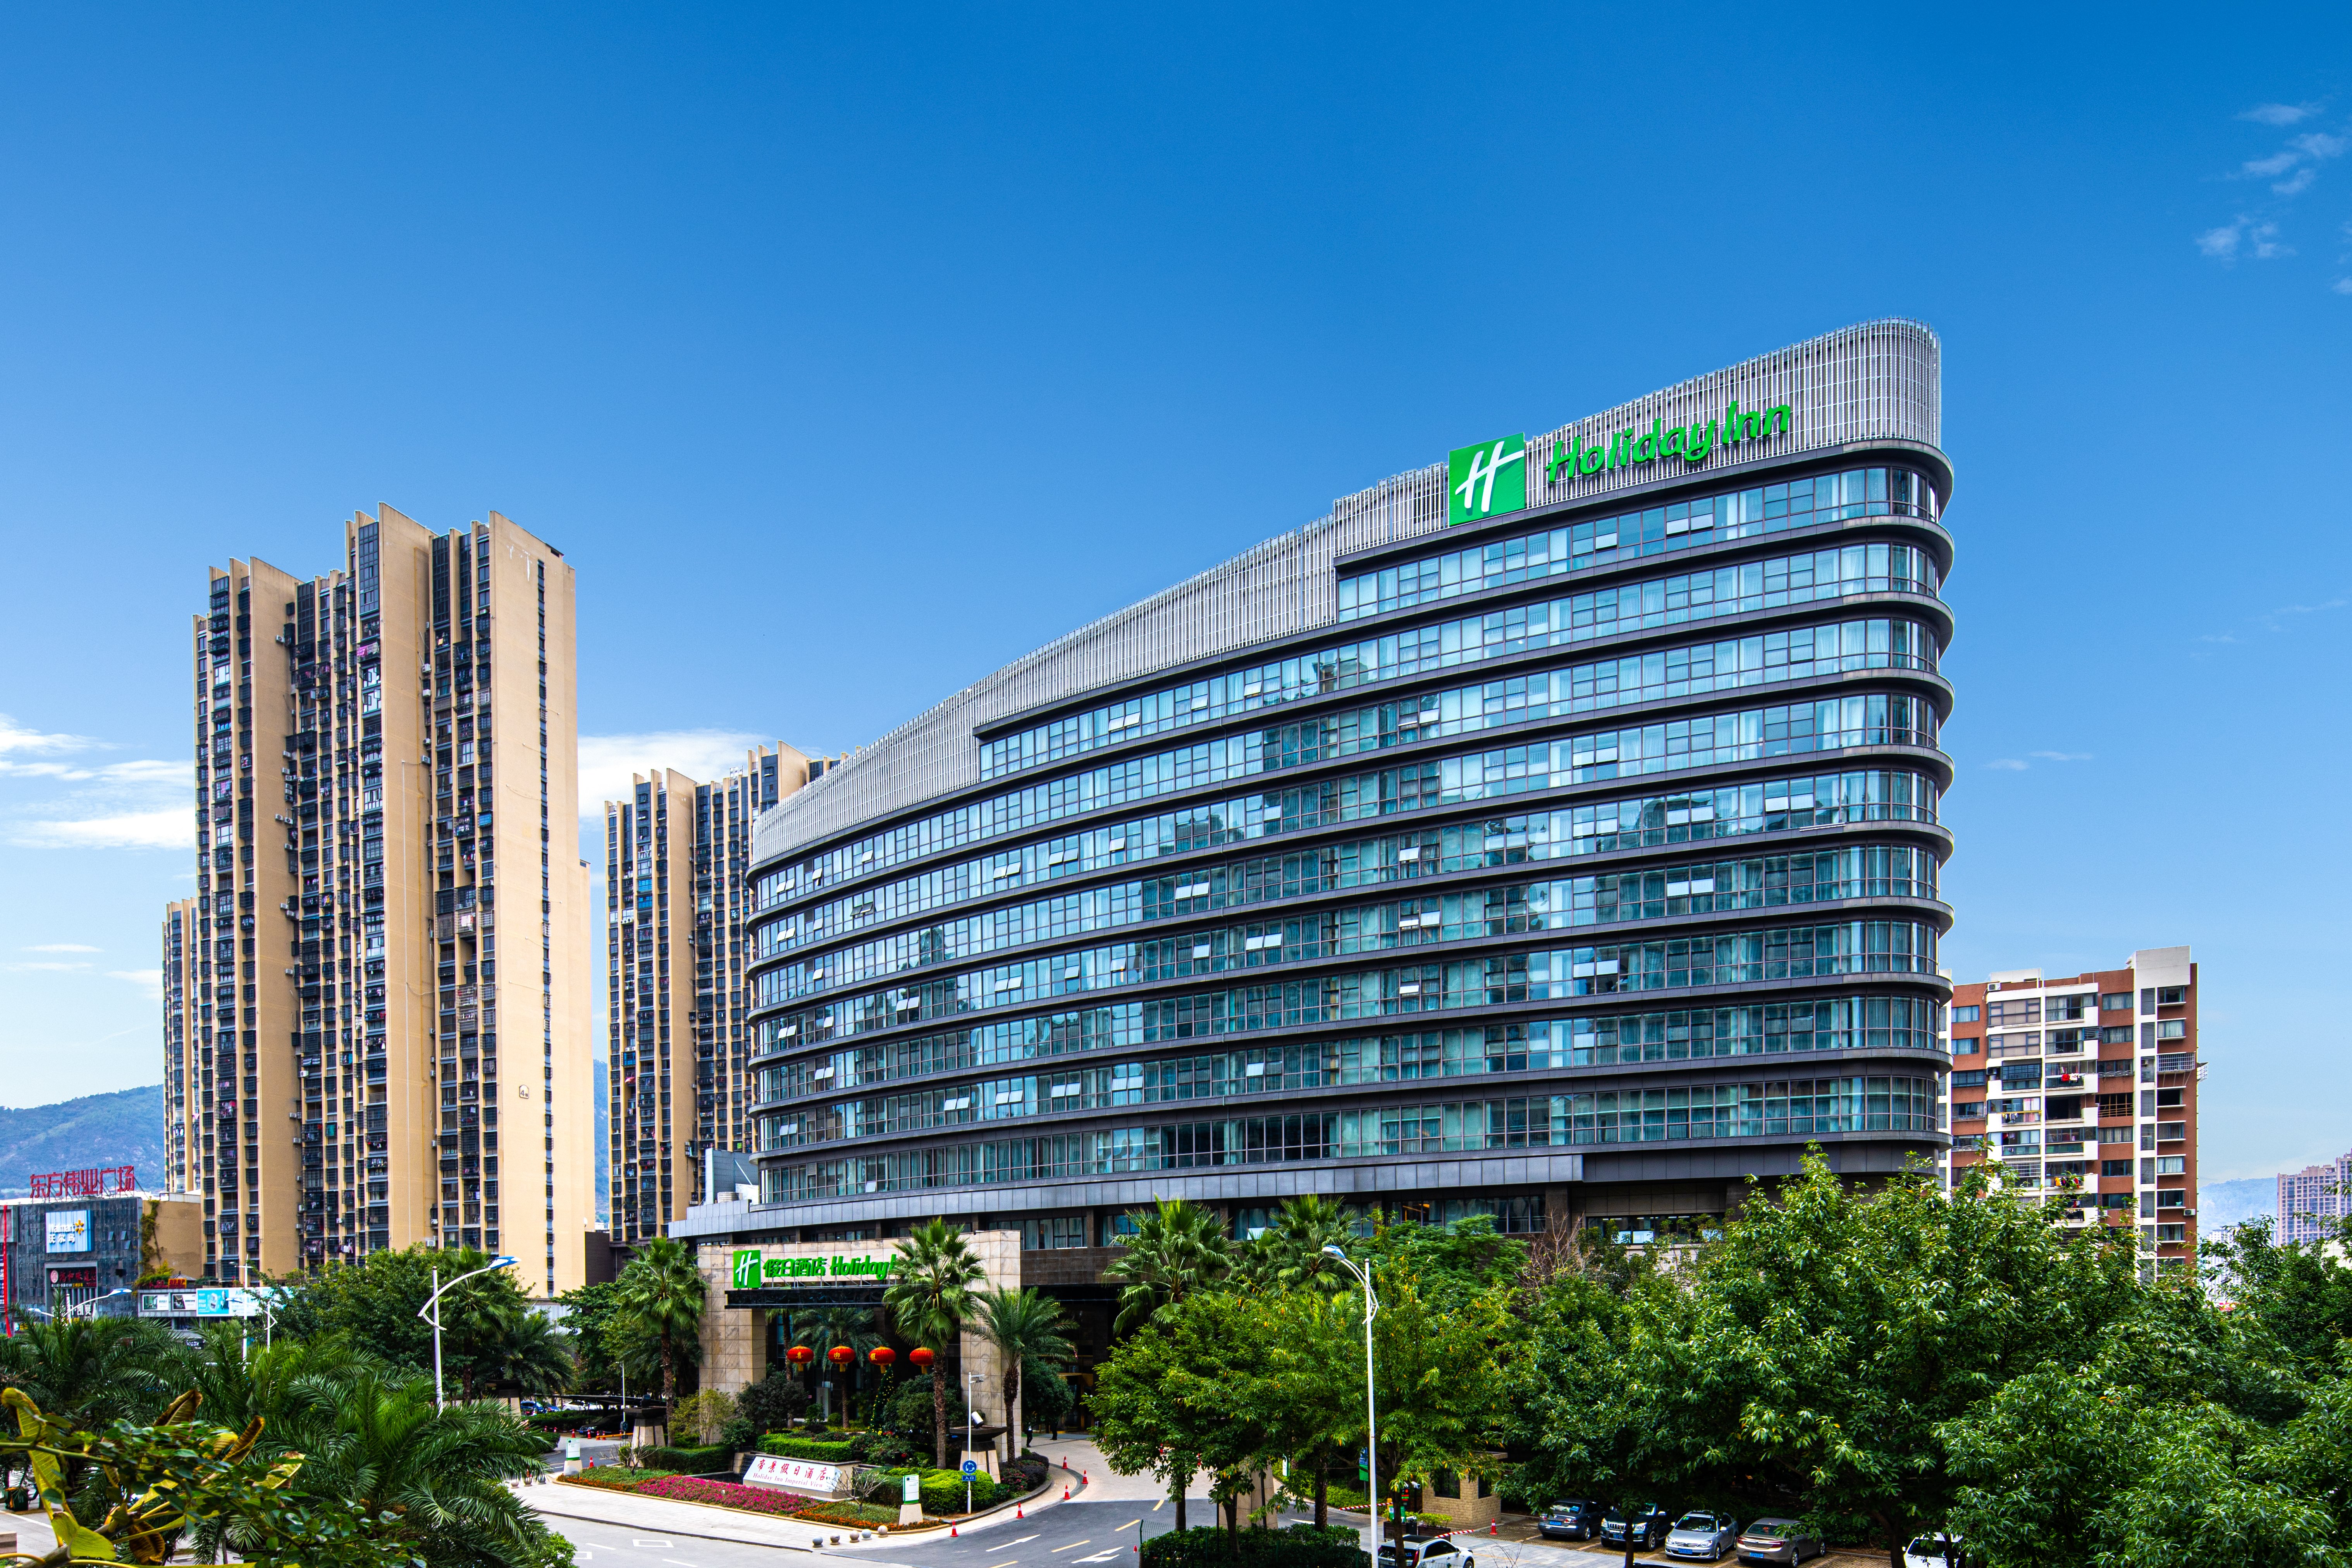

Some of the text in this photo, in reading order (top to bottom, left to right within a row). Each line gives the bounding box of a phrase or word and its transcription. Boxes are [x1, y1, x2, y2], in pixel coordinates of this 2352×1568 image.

[1546, 401, 1791, 482] Holiday Inn
[30, 1165, 134, 1198] 东方伟业广场
[48, 1224, 75, 1233] Walmart
[49, 1234, 75, 1243] 沃尔玛
[763, 1257, 828, 1278] 假日酒店
[830, 1255, 890, 1280] Holiday
[753, 1473, 773, 1481] Holiday
[785, 1477, 808, 1485] Imperial
[757, 1459, 828, 1481] 帝景假日酒店
